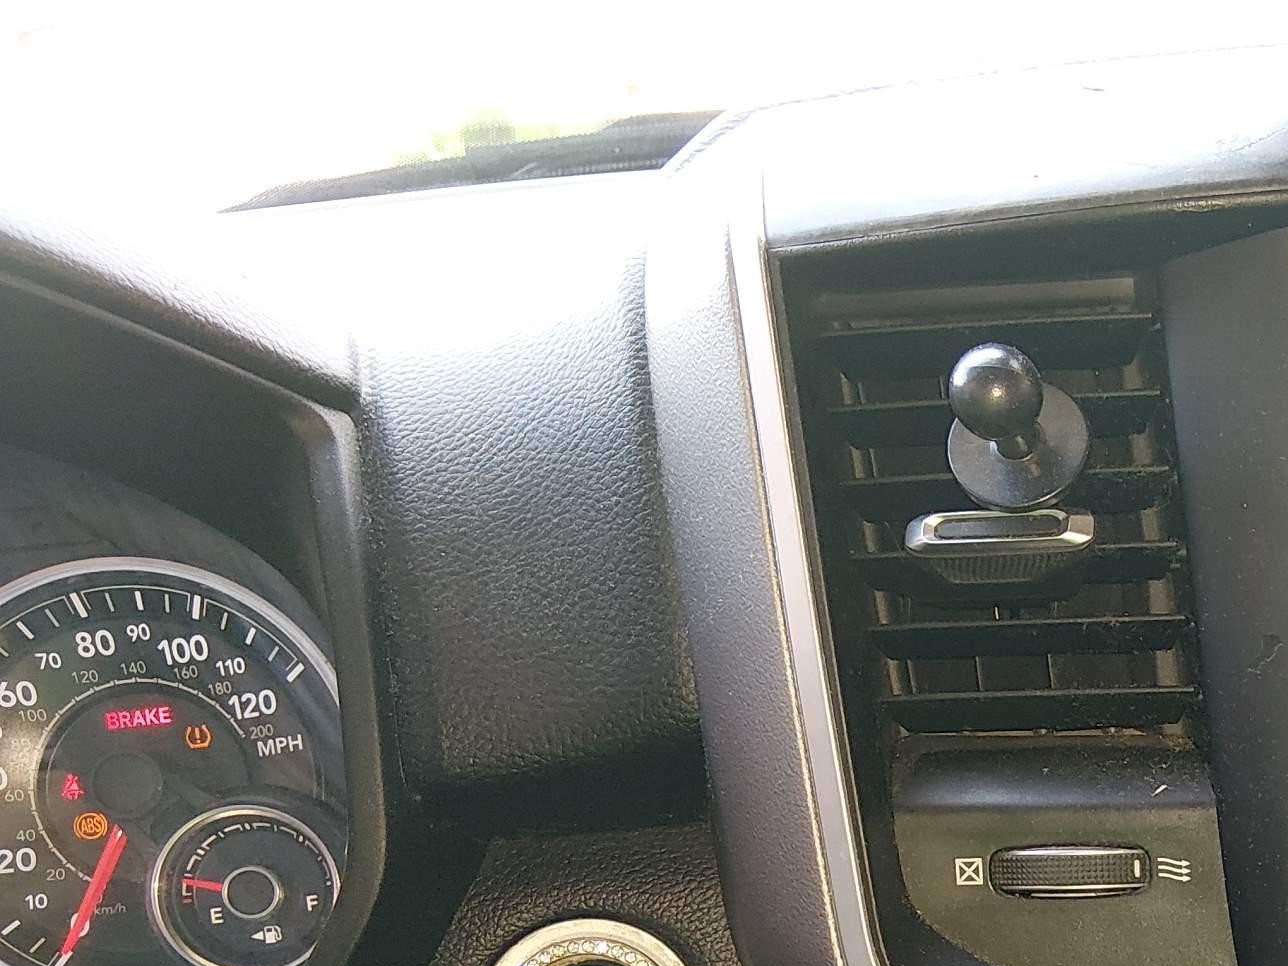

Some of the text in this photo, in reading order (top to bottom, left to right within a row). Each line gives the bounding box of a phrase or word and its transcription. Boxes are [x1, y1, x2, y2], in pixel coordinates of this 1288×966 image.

[127, 623, 150, 642] 90
[75, 629, 115, 658] 80
[157, 635, 209, 665] 100
[35, 653, 62, 670] 70
[120, 661, 146, 674] 140
[216, 657, 245, 677] 110
[72, 669, 99, 684] 120
[174, 665, 198, 679] 160
[0, 681, 38, 708] 60
[208, 681, 232, 696] 180
[228, 689, 277, 720] 120
[19, 709, 47, 722] 100
[105, 706, 172, 729] BRAKE
[250, 724, 274, 739] 200
[257, 734, 303, 757] MPH
[5, 789, 24, 802] 60
[81, 817, 102, 834] ABS
[16, 829, 36, 842] 40
[0, 848, 37, 874] 20
[46, 869, 65, 881] 20
[25, 893, 48, 910] 10
[306, 895, 319, 911] F
[210, 907, 224, 924] E
